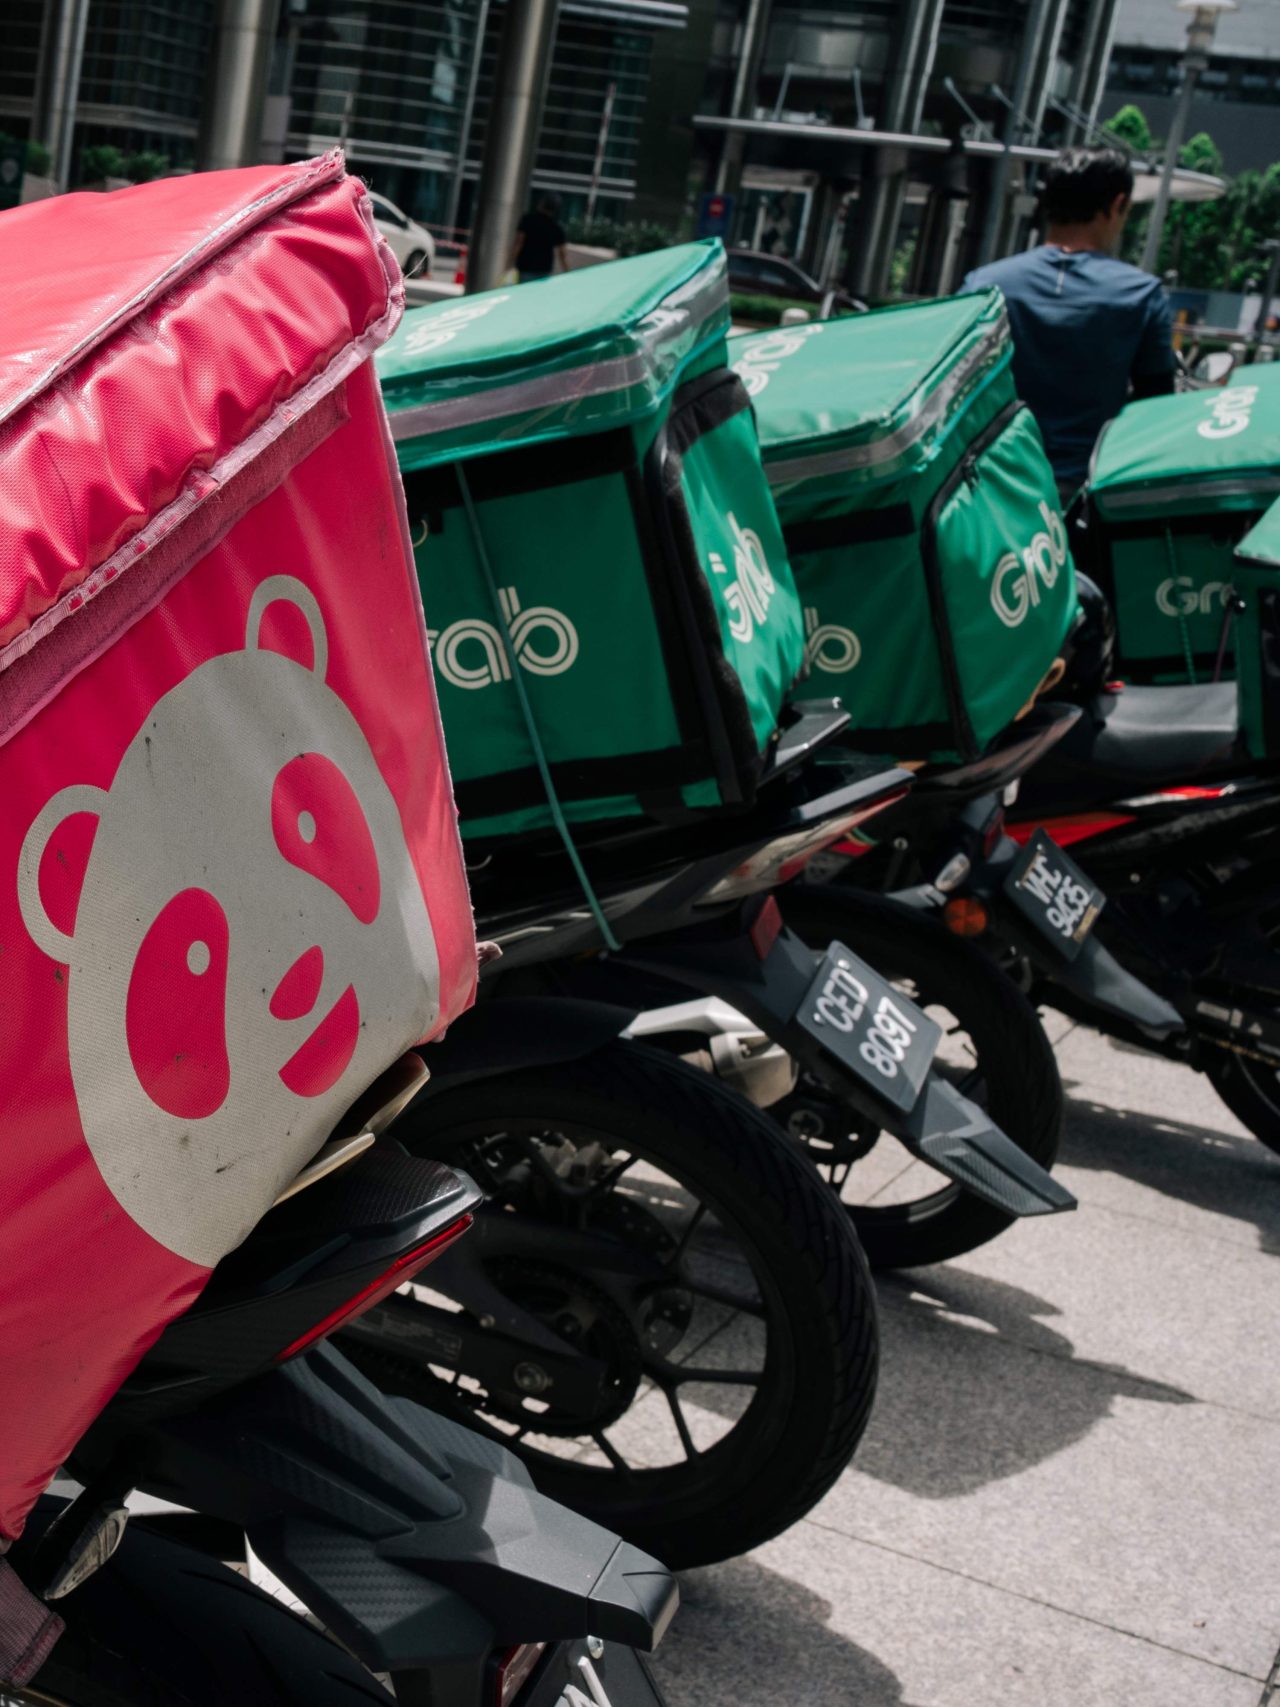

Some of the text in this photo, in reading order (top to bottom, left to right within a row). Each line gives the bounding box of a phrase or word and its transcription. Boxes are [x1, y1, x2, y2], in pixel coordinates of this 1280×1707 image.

[990, 500, 1066, 628] Grab
[1155, 575, 1234, 617] Gr
[426, 586, 580, 690] ab
[1022, 855, 1062, 904] VHC
[816, 967, 869, 1032] CED
[859, 996, 918, 1078] 8097
